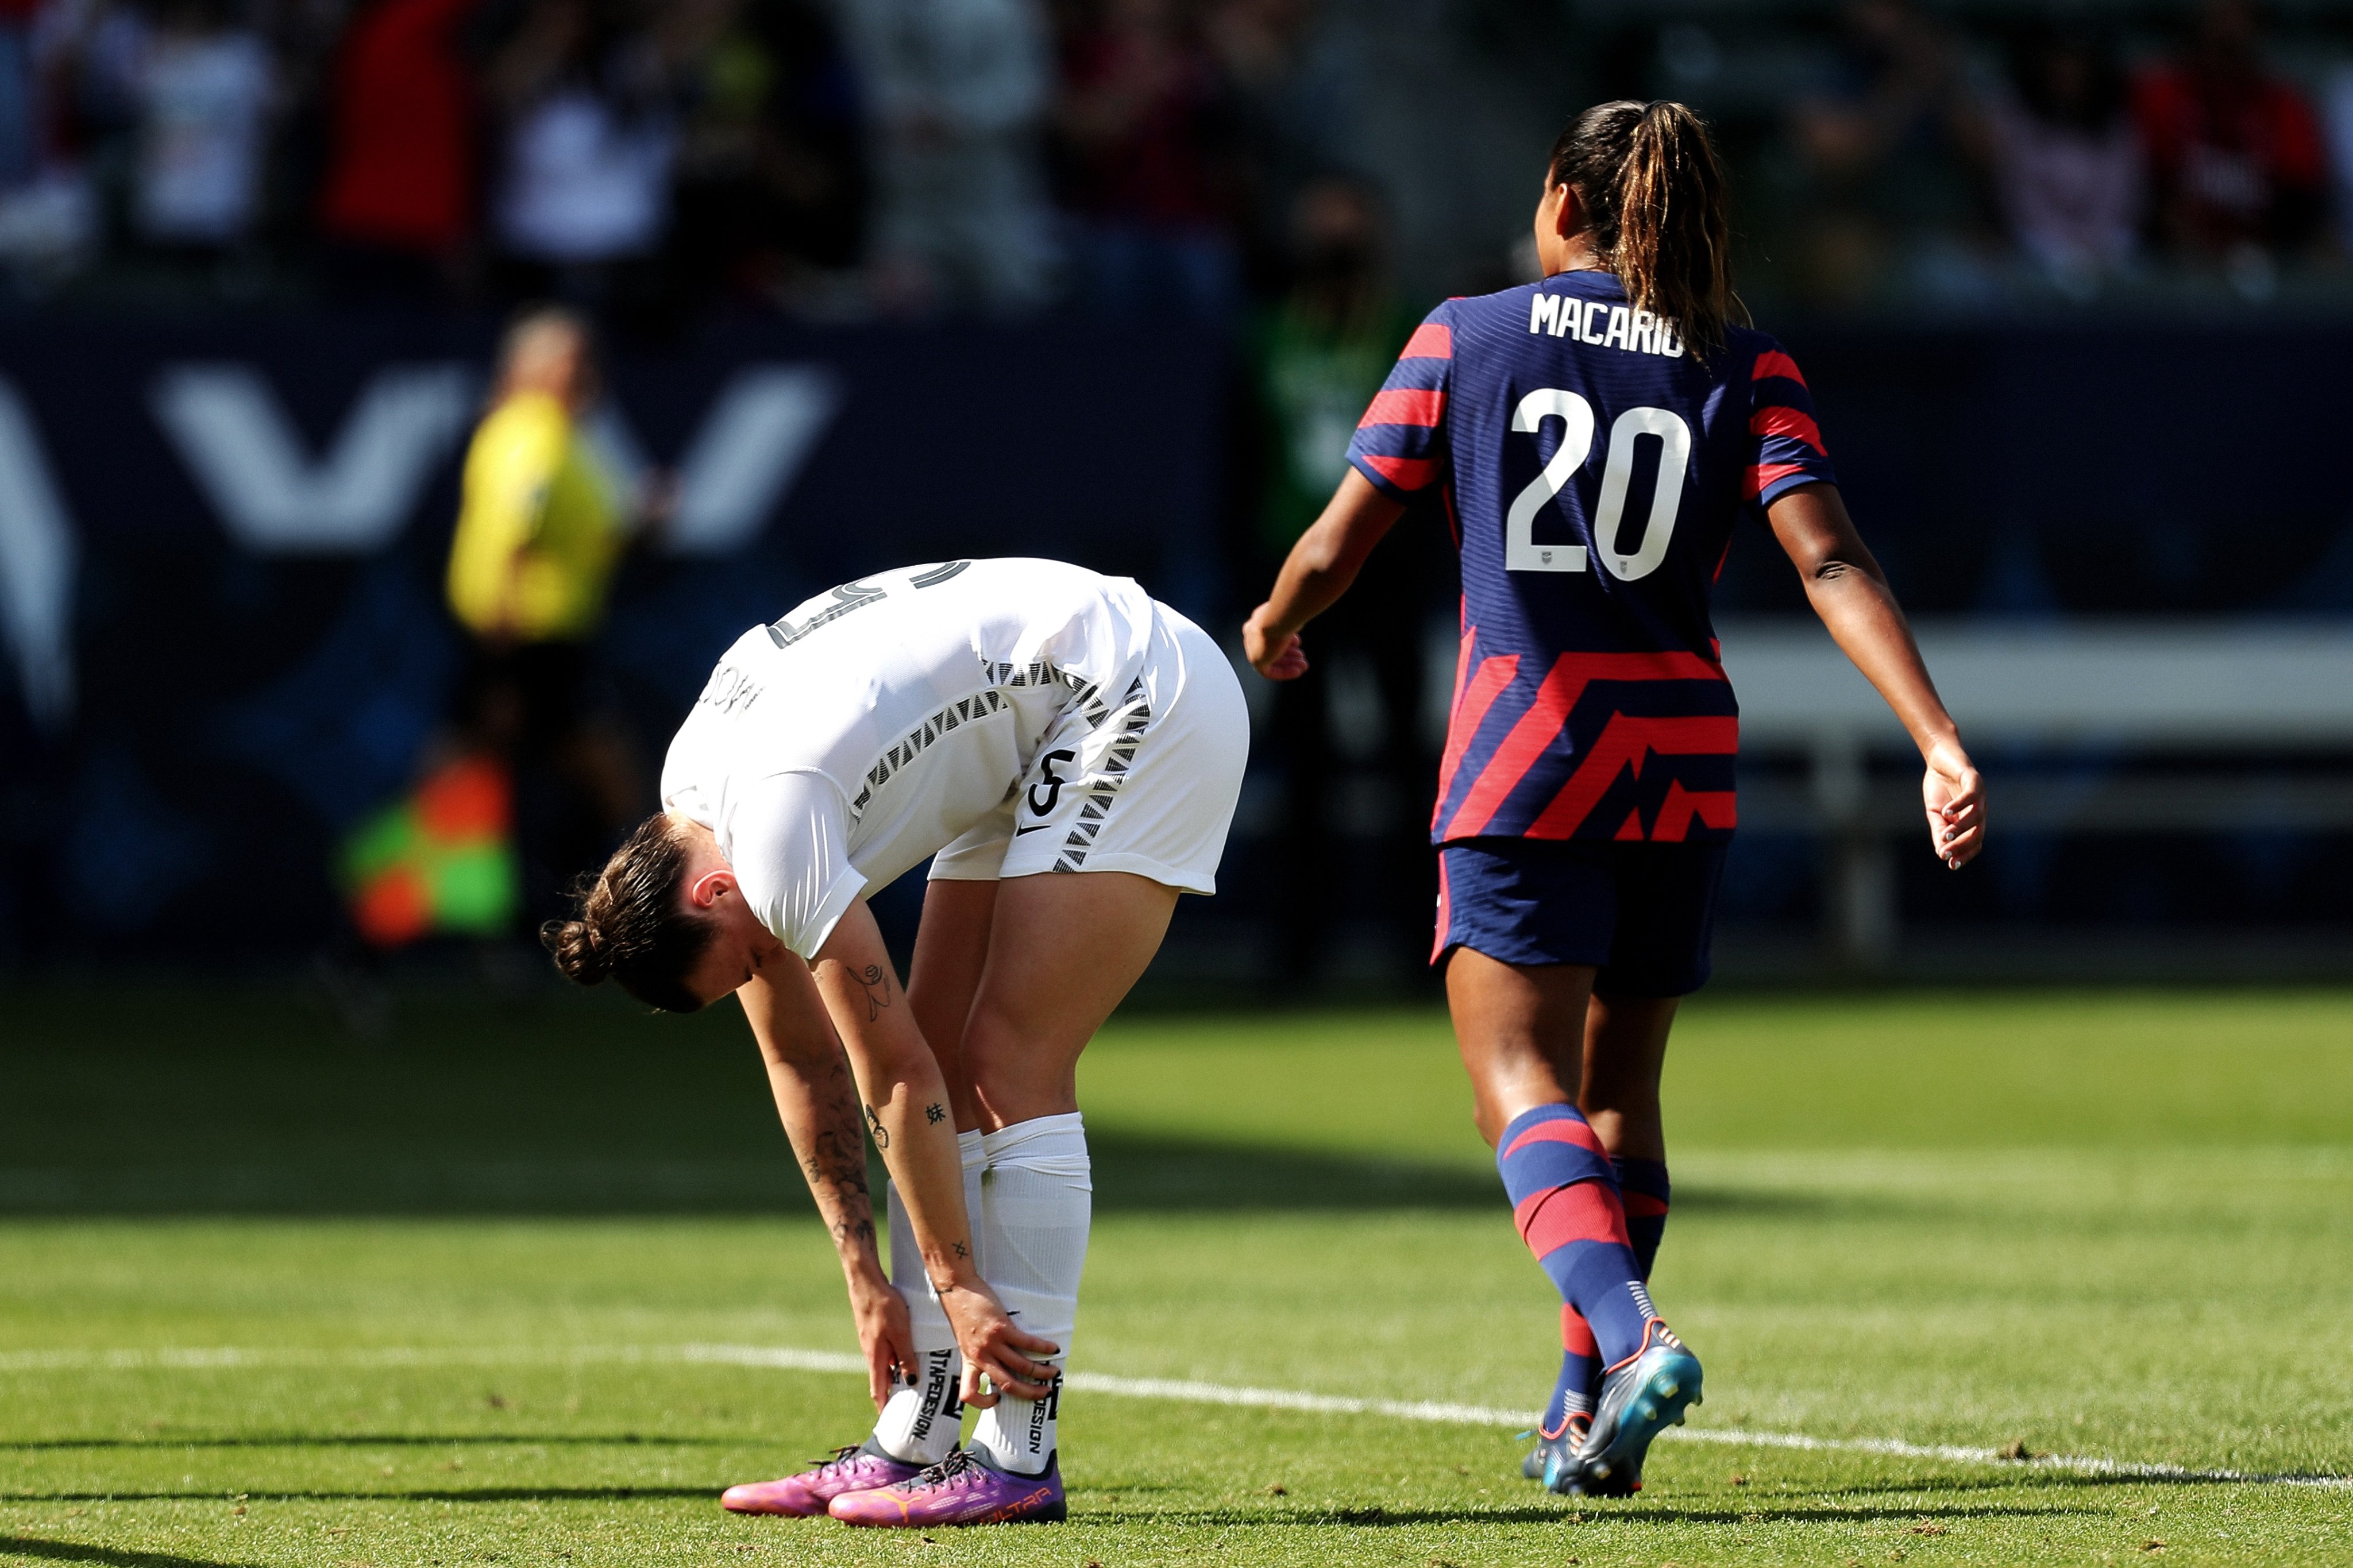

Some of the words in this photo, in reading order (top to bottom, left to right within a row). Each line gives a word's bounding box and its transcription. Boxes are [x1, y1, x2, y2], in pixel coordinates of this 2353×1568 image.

[1529, 292, 1684, 358] MACARIO
[1505, 388, 1691, 581] 20
[1028, 749, 1077, 817] 5
[981, 1487, 1052, 1524] ULTRA
